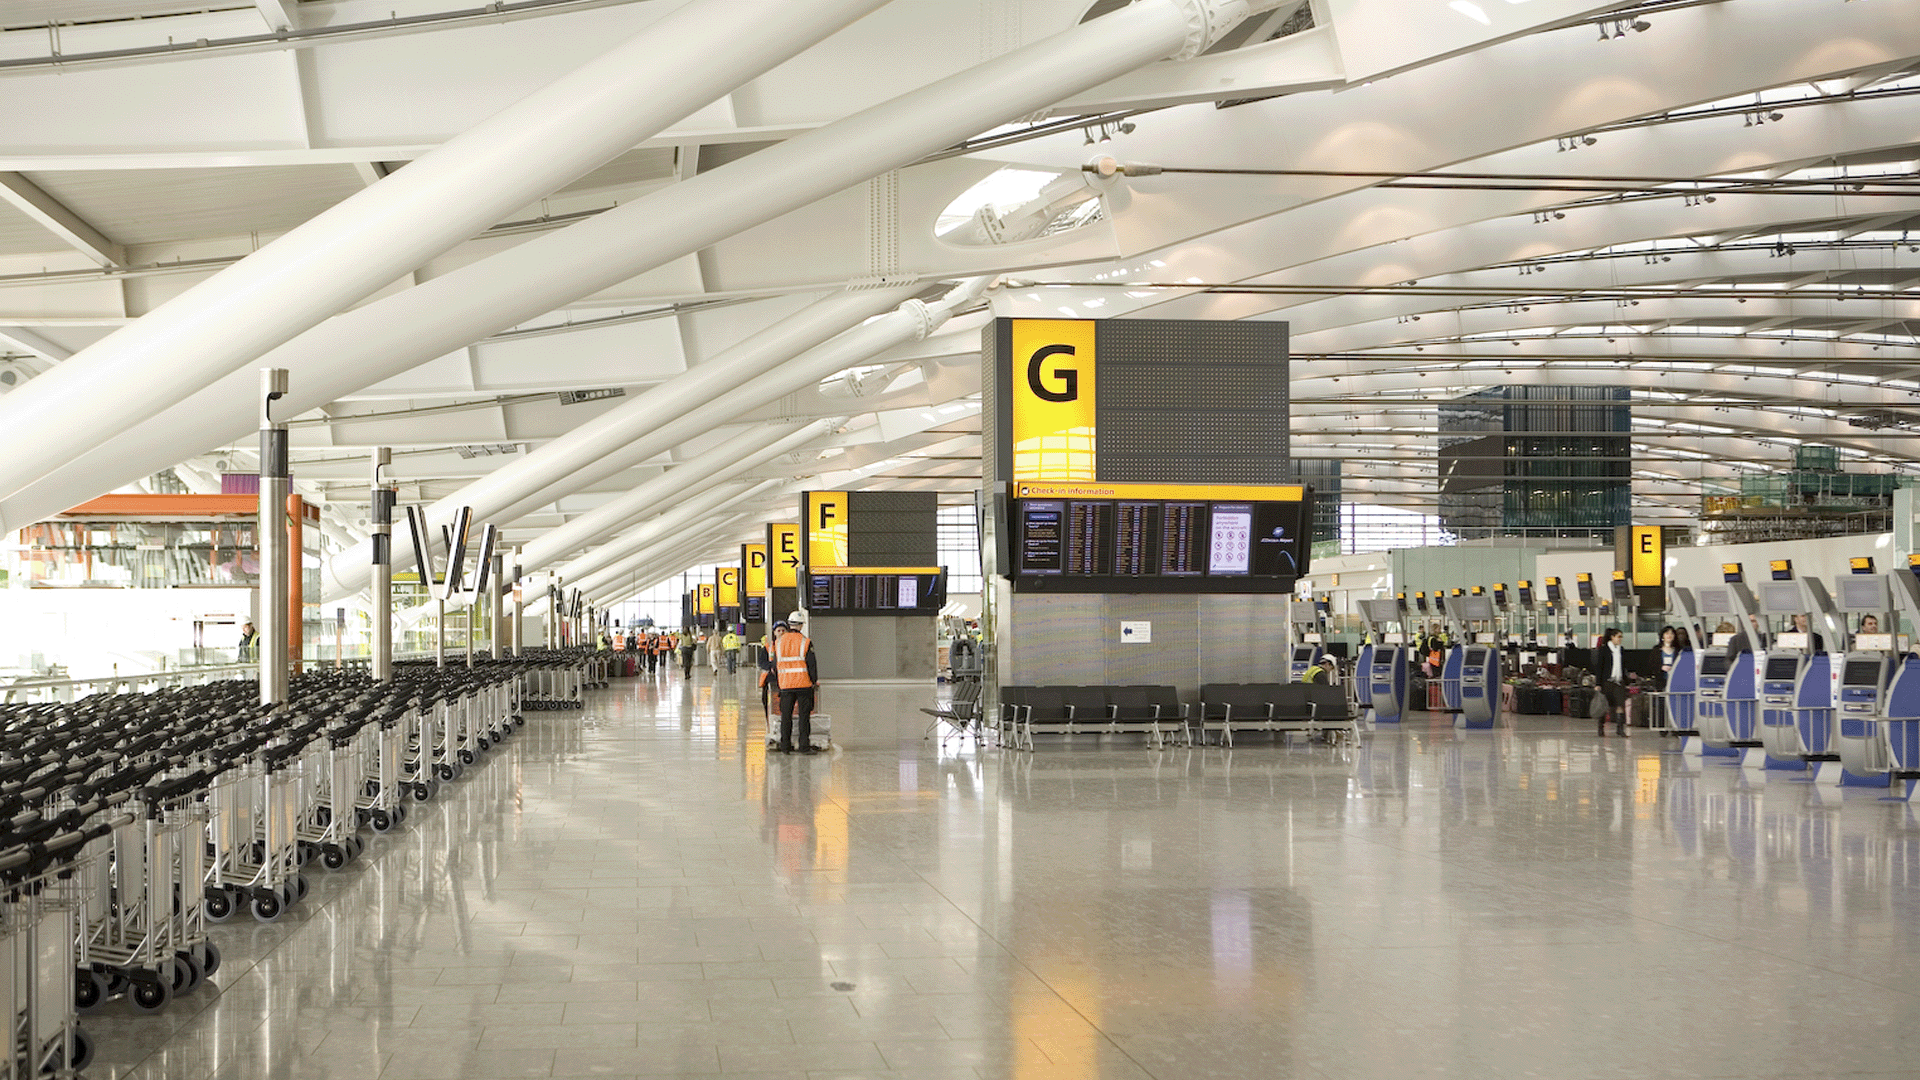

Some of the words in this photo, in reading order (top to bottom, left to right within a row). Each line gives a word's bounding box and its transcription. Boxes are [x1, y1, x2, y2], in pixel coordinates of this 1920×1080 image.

[1028, 344, 1078, 402] G
[1068, 487, 1115, 496] information
[820, 503, 836, 529] F
[781, 532, 794, 553] E
[1641, 534, 1653, 553] E
[752, 551, 766, 568] D
[723, 572, 733, 586] C
[703, 587, 711, 597] B
